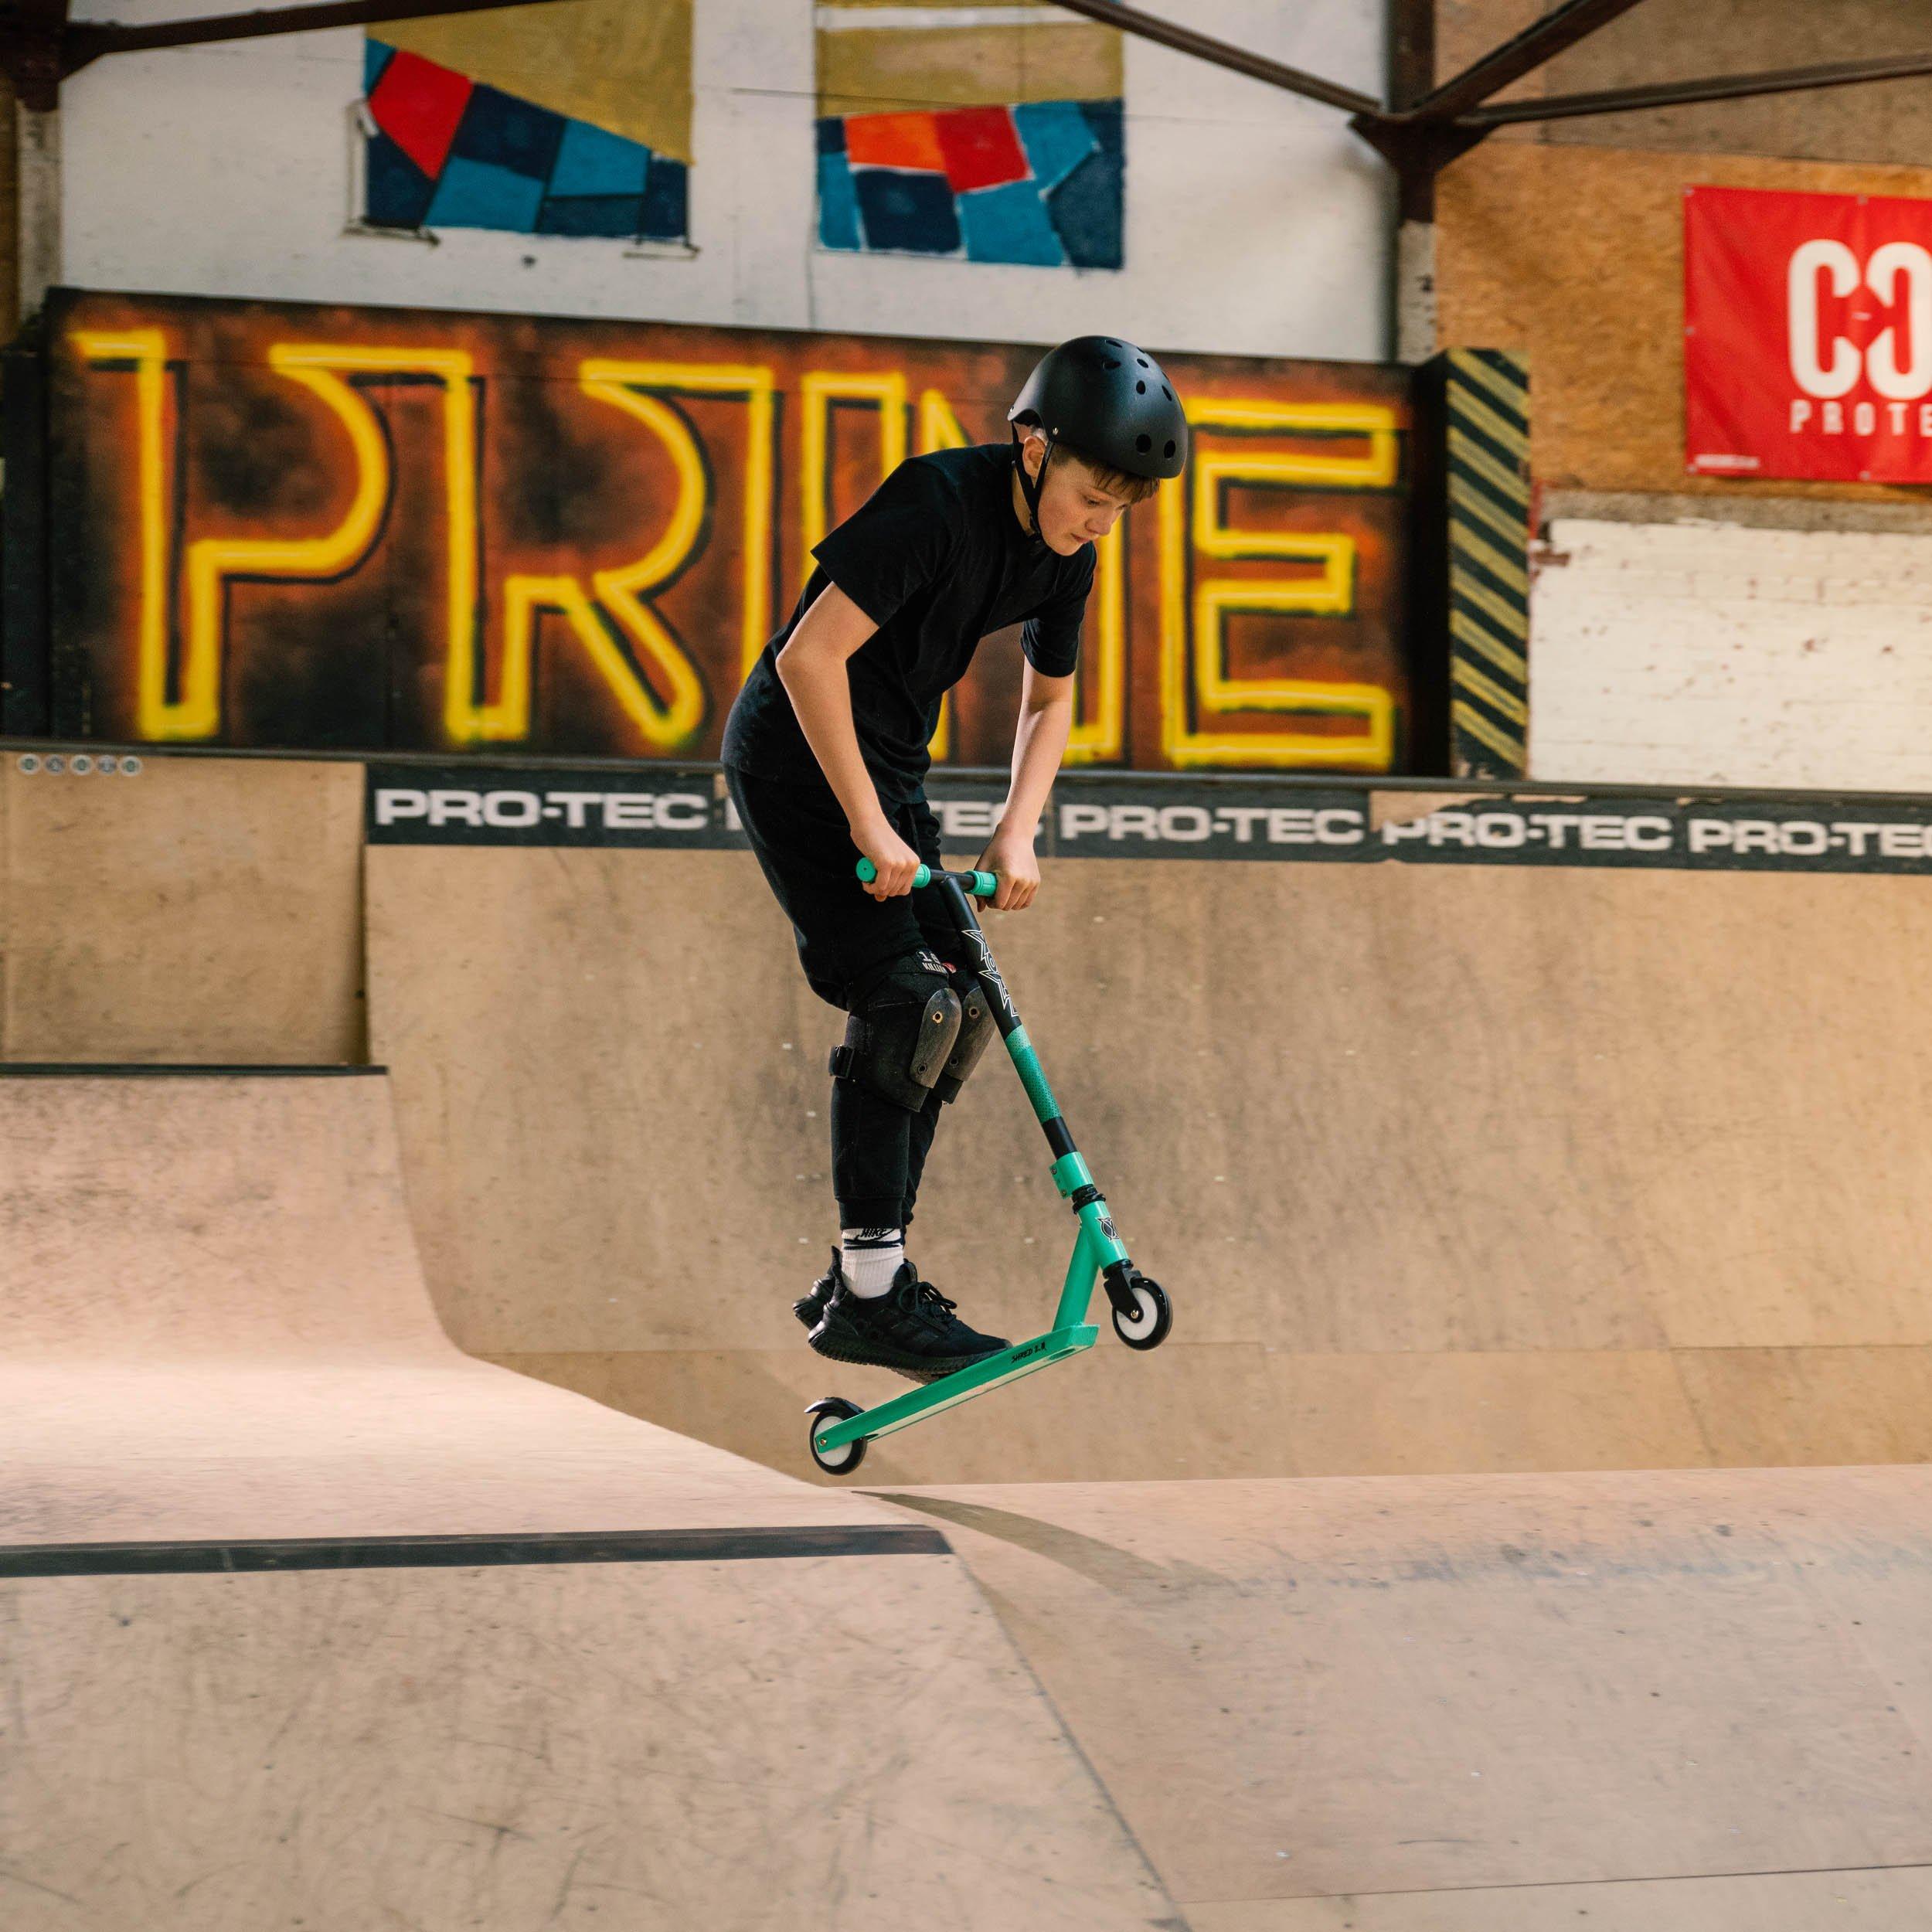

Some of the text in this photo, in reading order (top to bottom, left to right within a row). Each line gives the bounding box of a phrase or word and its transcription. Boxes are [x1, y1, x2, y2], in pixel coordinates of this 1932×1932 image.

[376, 788, 707, 829] PRO-TEC
[1061, 804, 1363, 844] PRO-TEC
[1381, 810, 1672, 851] PRO-TEC
[1688, 818, 1932, 858] PRO-TE
